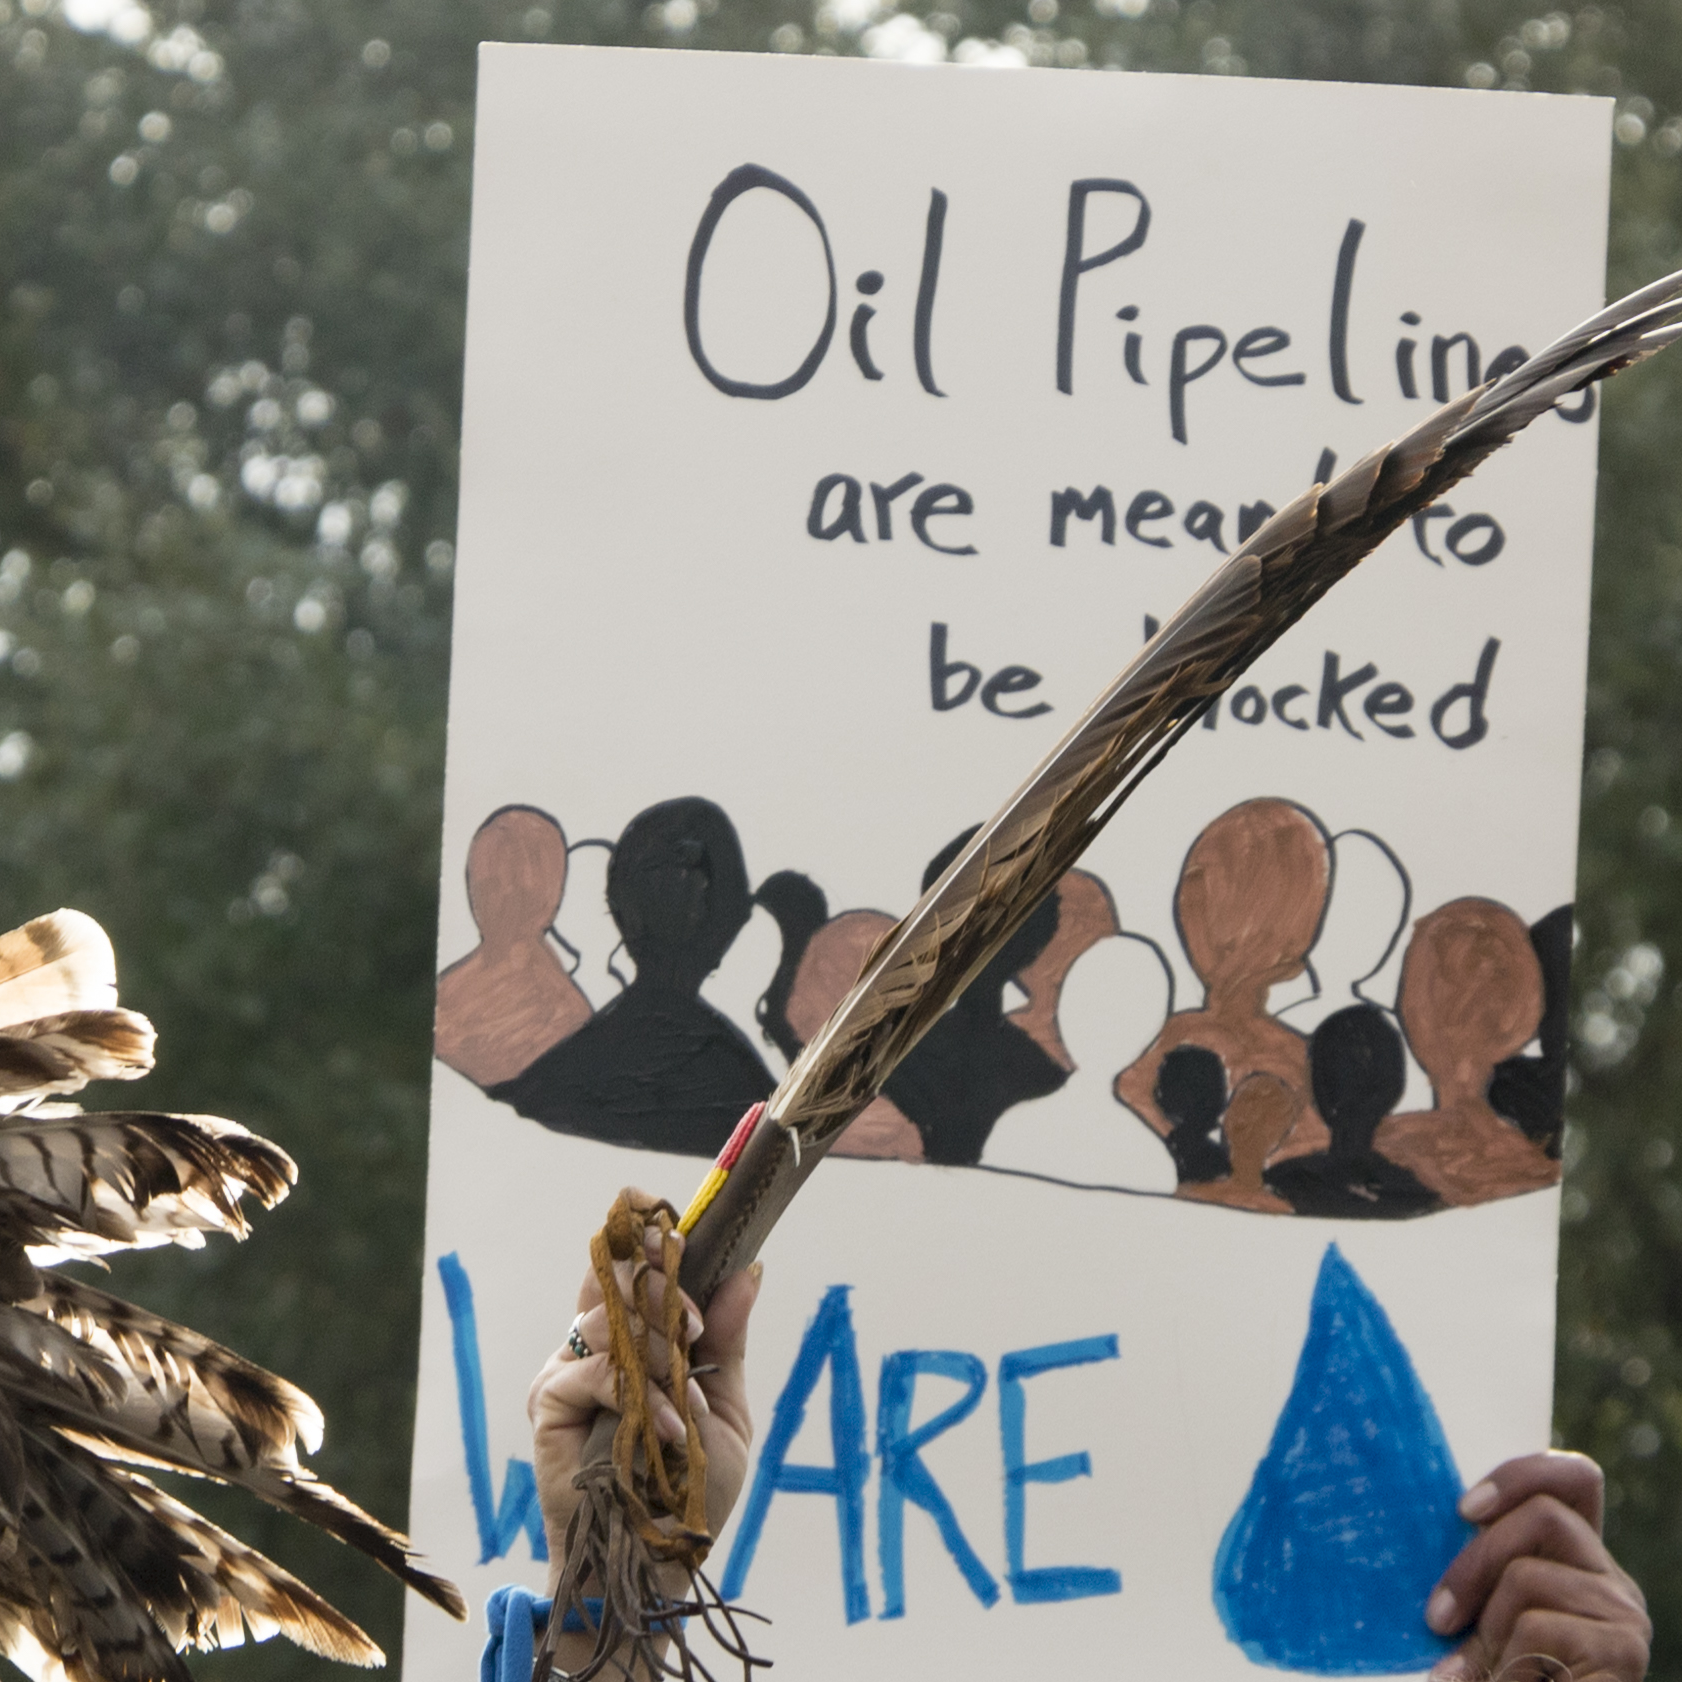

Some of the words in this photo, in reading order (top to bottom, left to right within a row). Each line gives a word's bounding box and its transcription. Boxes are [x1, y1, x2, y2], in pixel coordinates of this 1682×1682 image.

[683, 162, 949, 401] Oil
[806, 471, 980, 556] are
[1413, 502, 1507, 567] to
[929, 622, 1055, 720] be
[1144, 612, 1501, 751] ocked
[720, 1283, 1122, 1625] ARE
